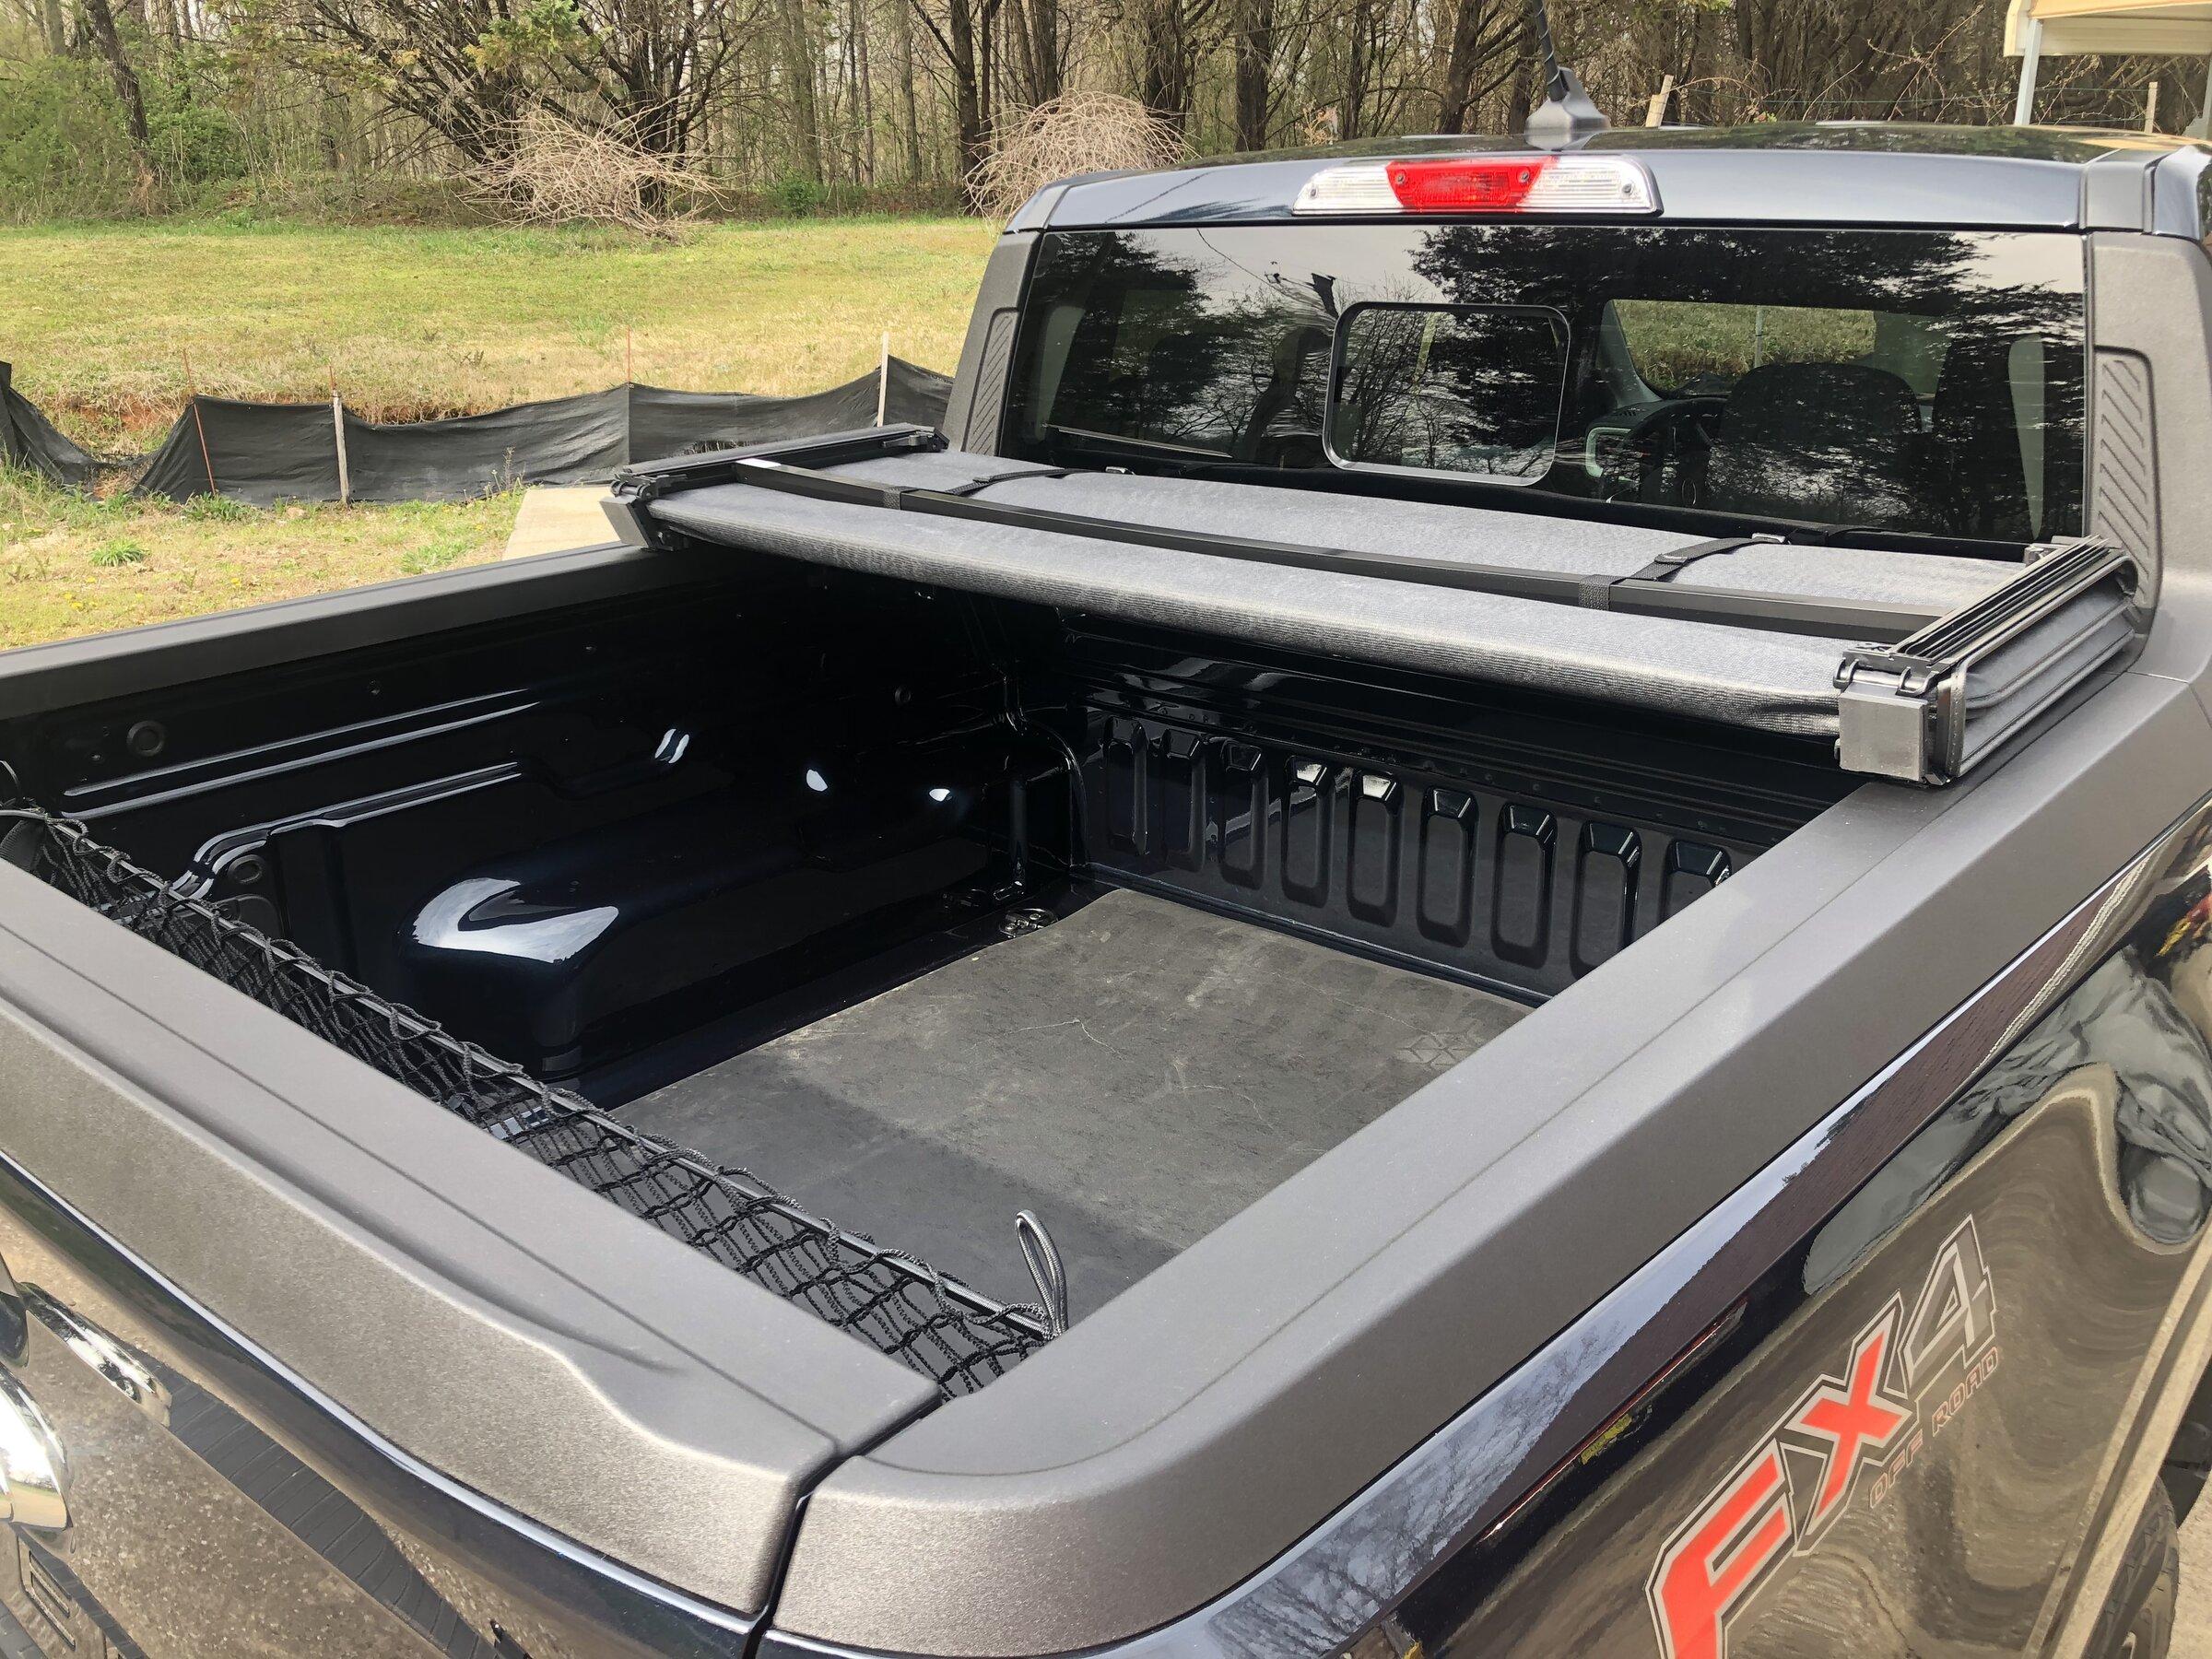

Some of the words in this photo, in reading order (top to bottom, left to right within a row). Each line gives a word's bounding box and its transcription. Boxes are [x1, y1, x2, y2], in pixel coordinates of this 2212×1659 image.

[1645, 1214, 1996, 1659] FX4
[1869, 1429, 1924, 1509] OFF
[1931, 1346, 1999, 1438] ROAD
